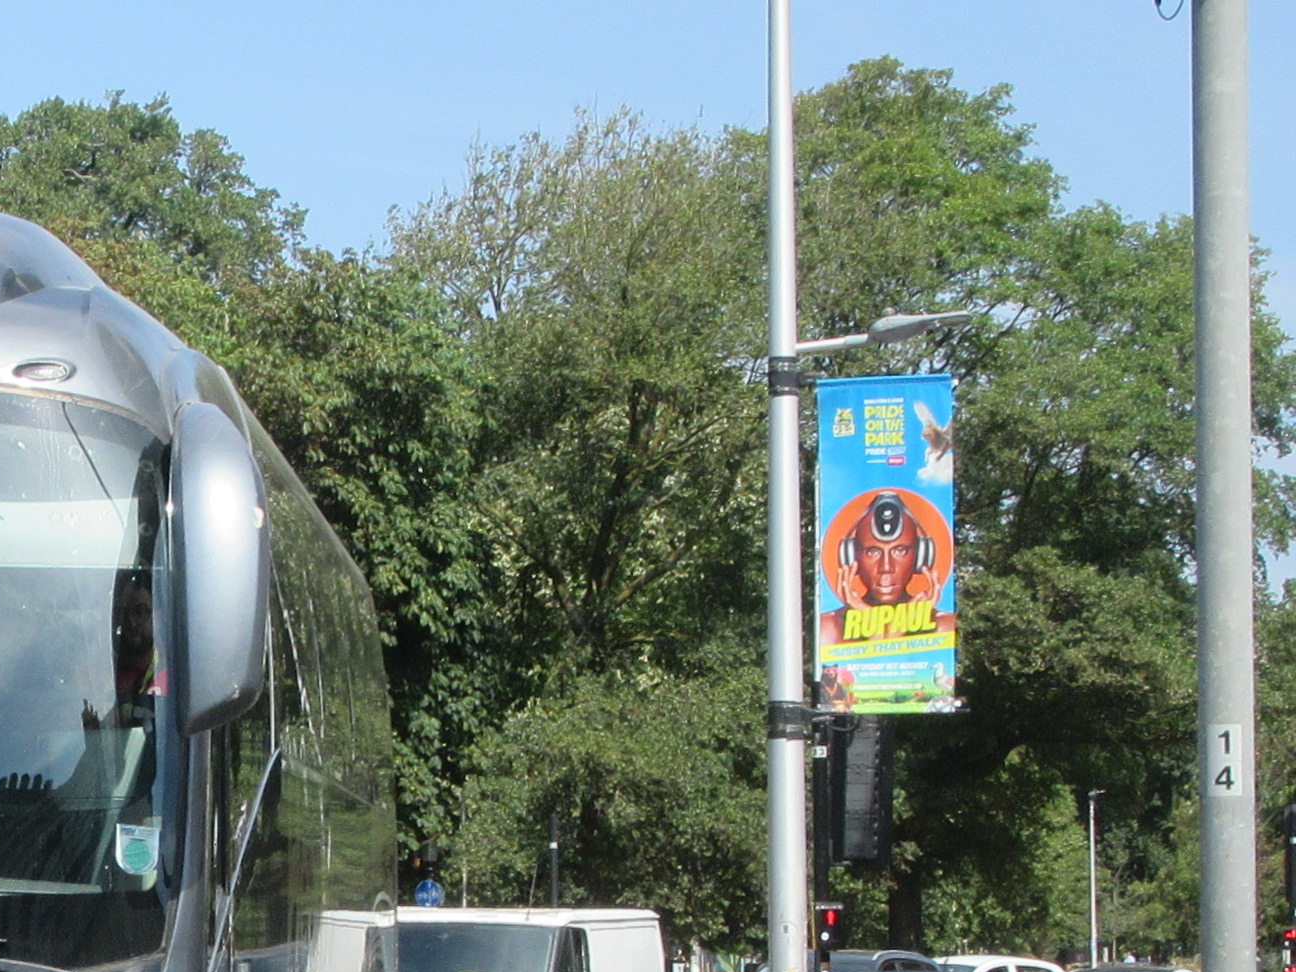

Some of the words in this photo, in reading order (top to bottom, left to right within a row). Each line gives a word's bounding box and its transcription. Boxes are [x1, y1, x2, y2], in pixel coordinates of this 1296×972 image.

[865, 405, 904, 419] PRIDE
[865, 420, 883, 431] ON
[885, 419, 905, 431] THE
[865, 432, 905, 446] PARK
[843, 601, 936, 640] RUPAUL
[872, 641, 904, 652] THAT
